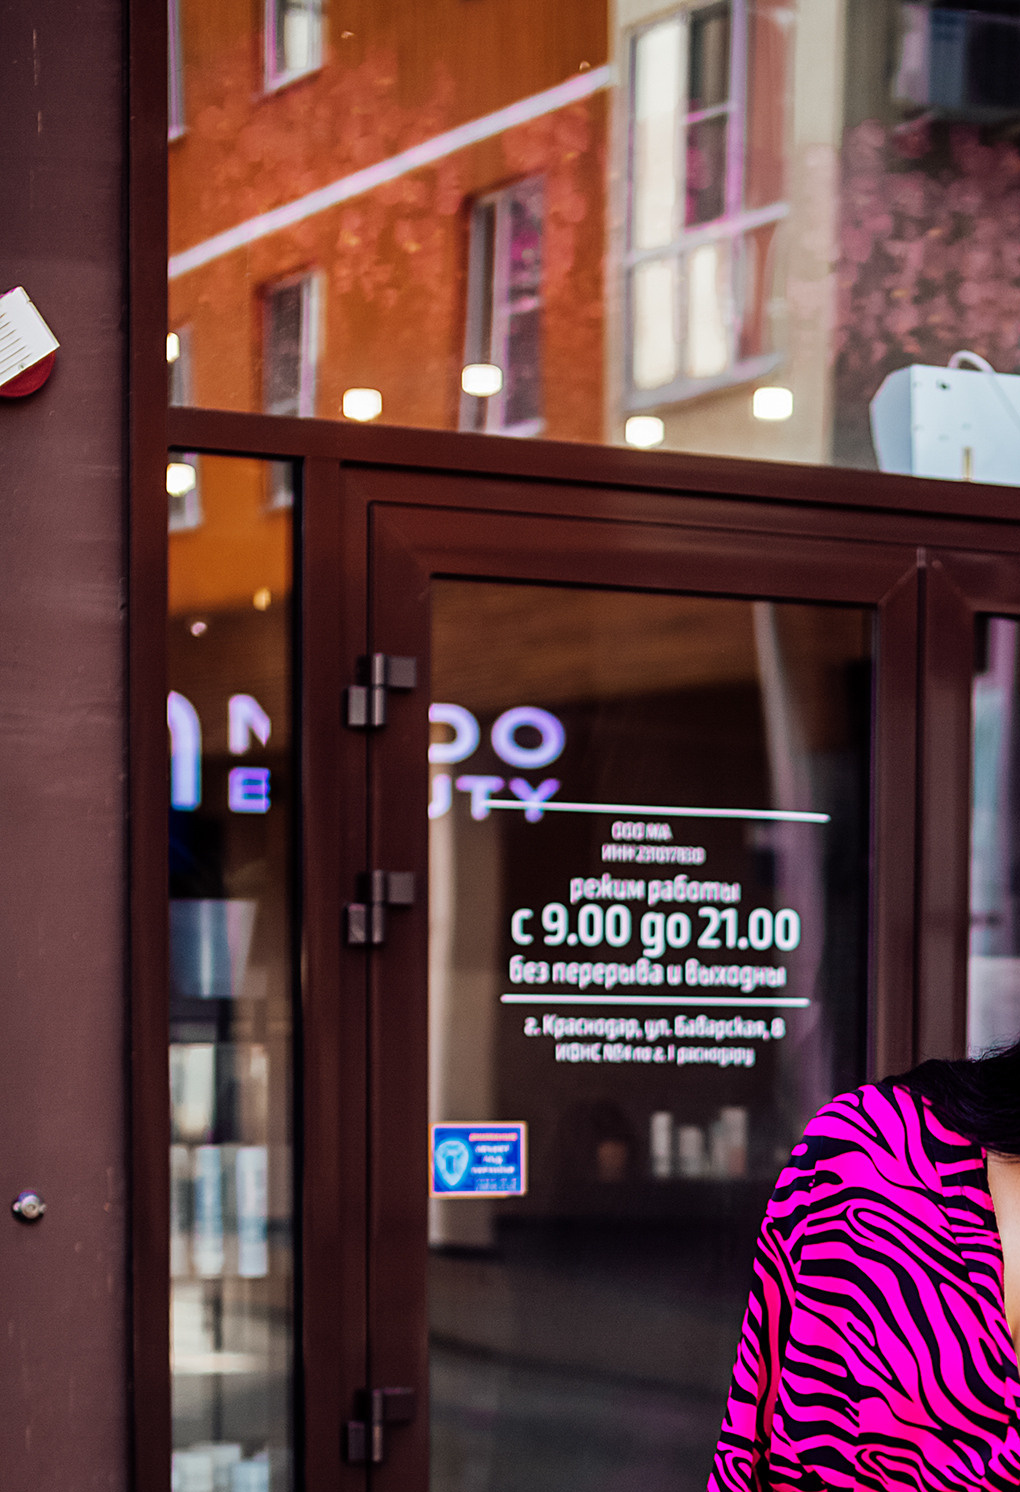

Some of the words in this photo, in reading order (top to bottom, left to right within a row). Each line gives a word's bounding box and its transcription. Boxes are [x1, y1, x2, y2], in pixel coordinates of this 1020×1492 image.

[570, 873, 645, 904] режим
[647, 875, 741, 906] работы
[511, 909, 533, 945] с
[541, 902, 631, 947] 9.00
[639, 911, 693, 959] до
[697, 907, 801, 952] 21.00
[509, 954, 550, 984] без
[551, 957, 664, 990] перерыва
[666, 964, 683, 986] и
